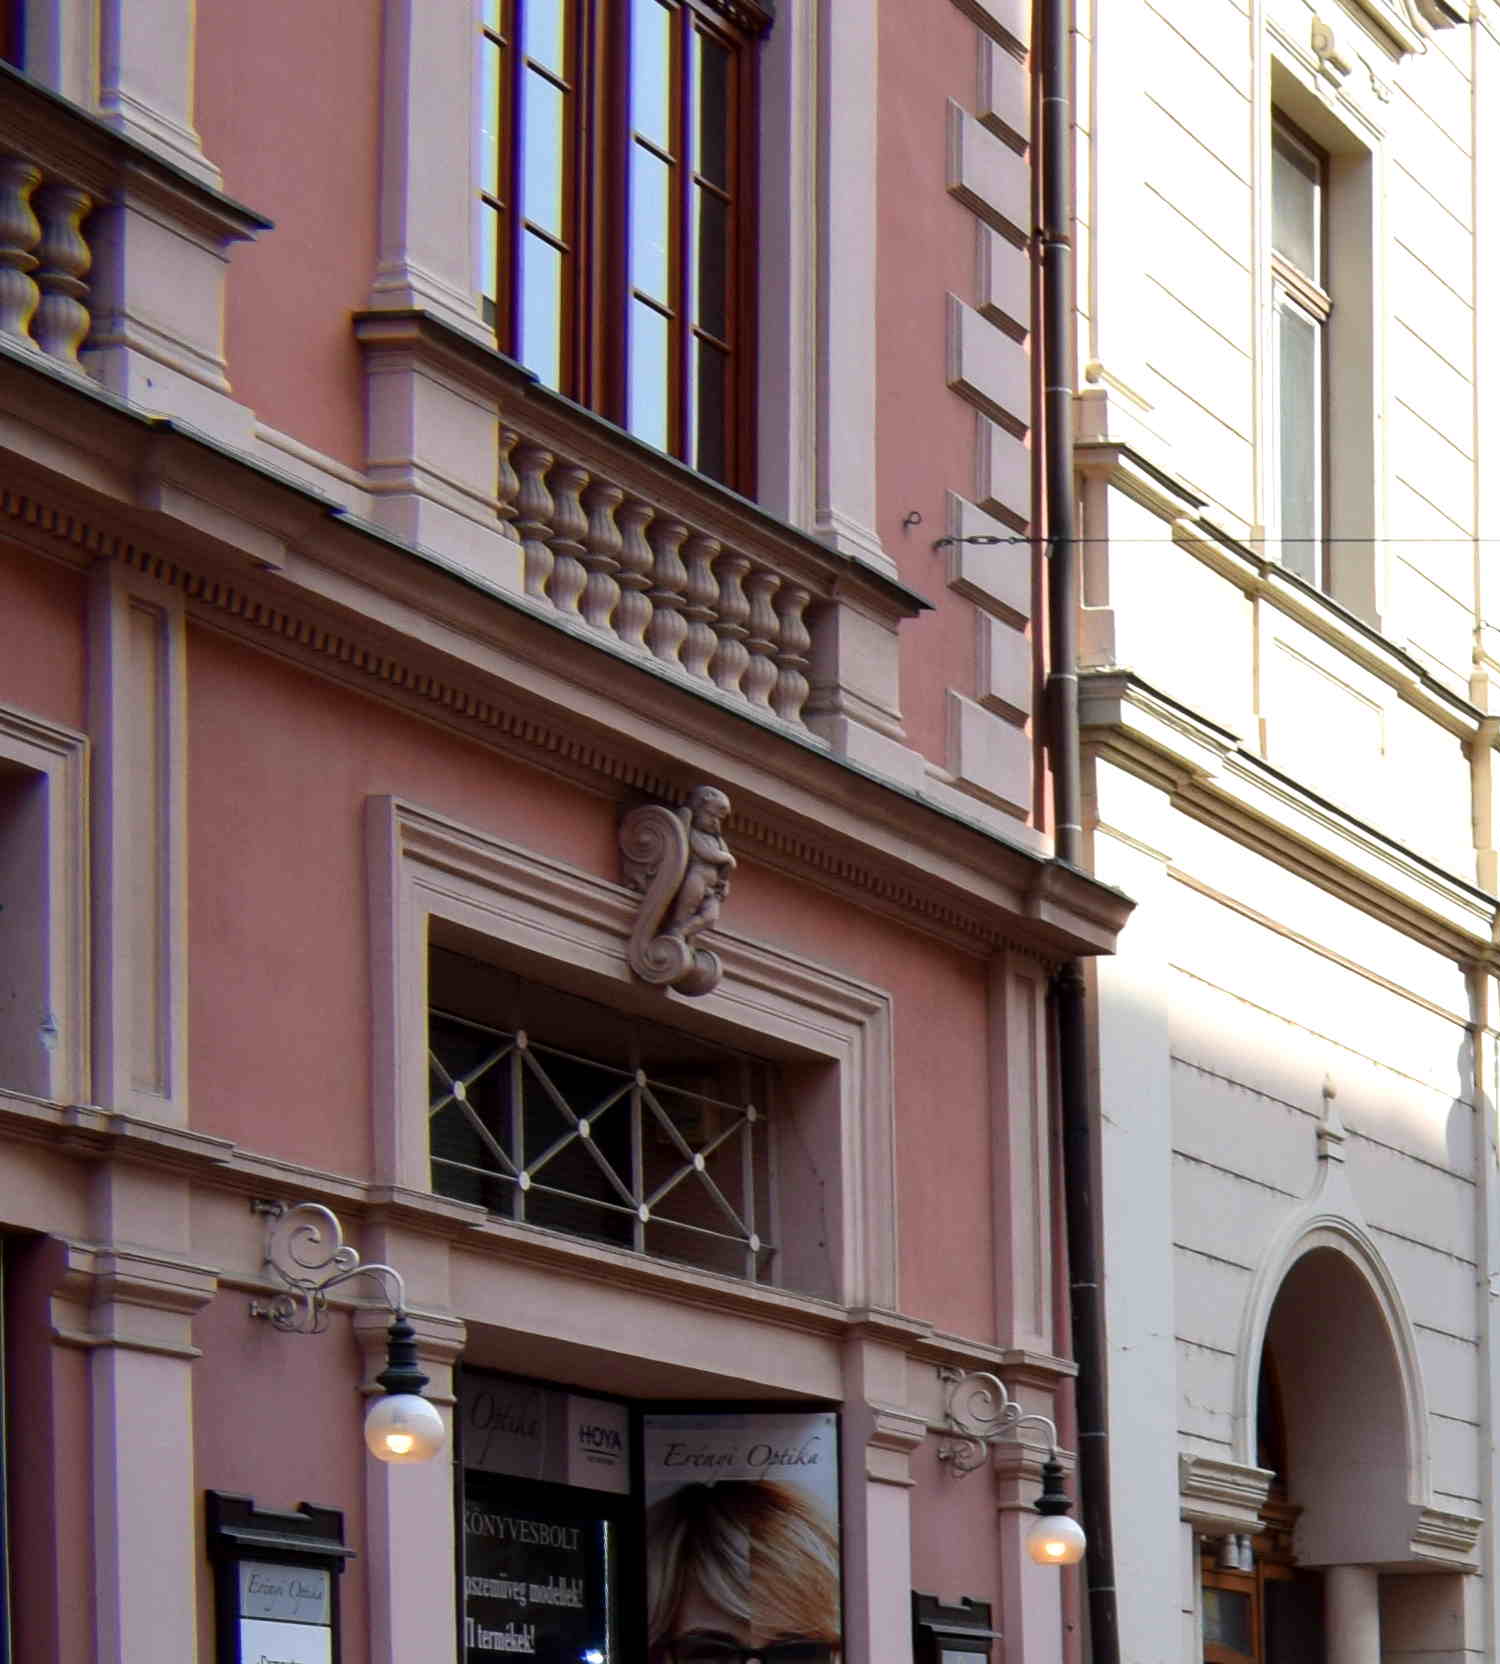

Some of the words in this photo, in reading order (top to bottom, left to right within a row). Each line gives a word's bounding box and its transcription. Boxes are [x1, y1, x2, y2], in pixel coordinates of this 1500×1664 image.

[578, 1423, 622, 1449] HOYA
[664, 1441, 735, 1482] Erényi
[746, 1436, 821, 1480] Optika
